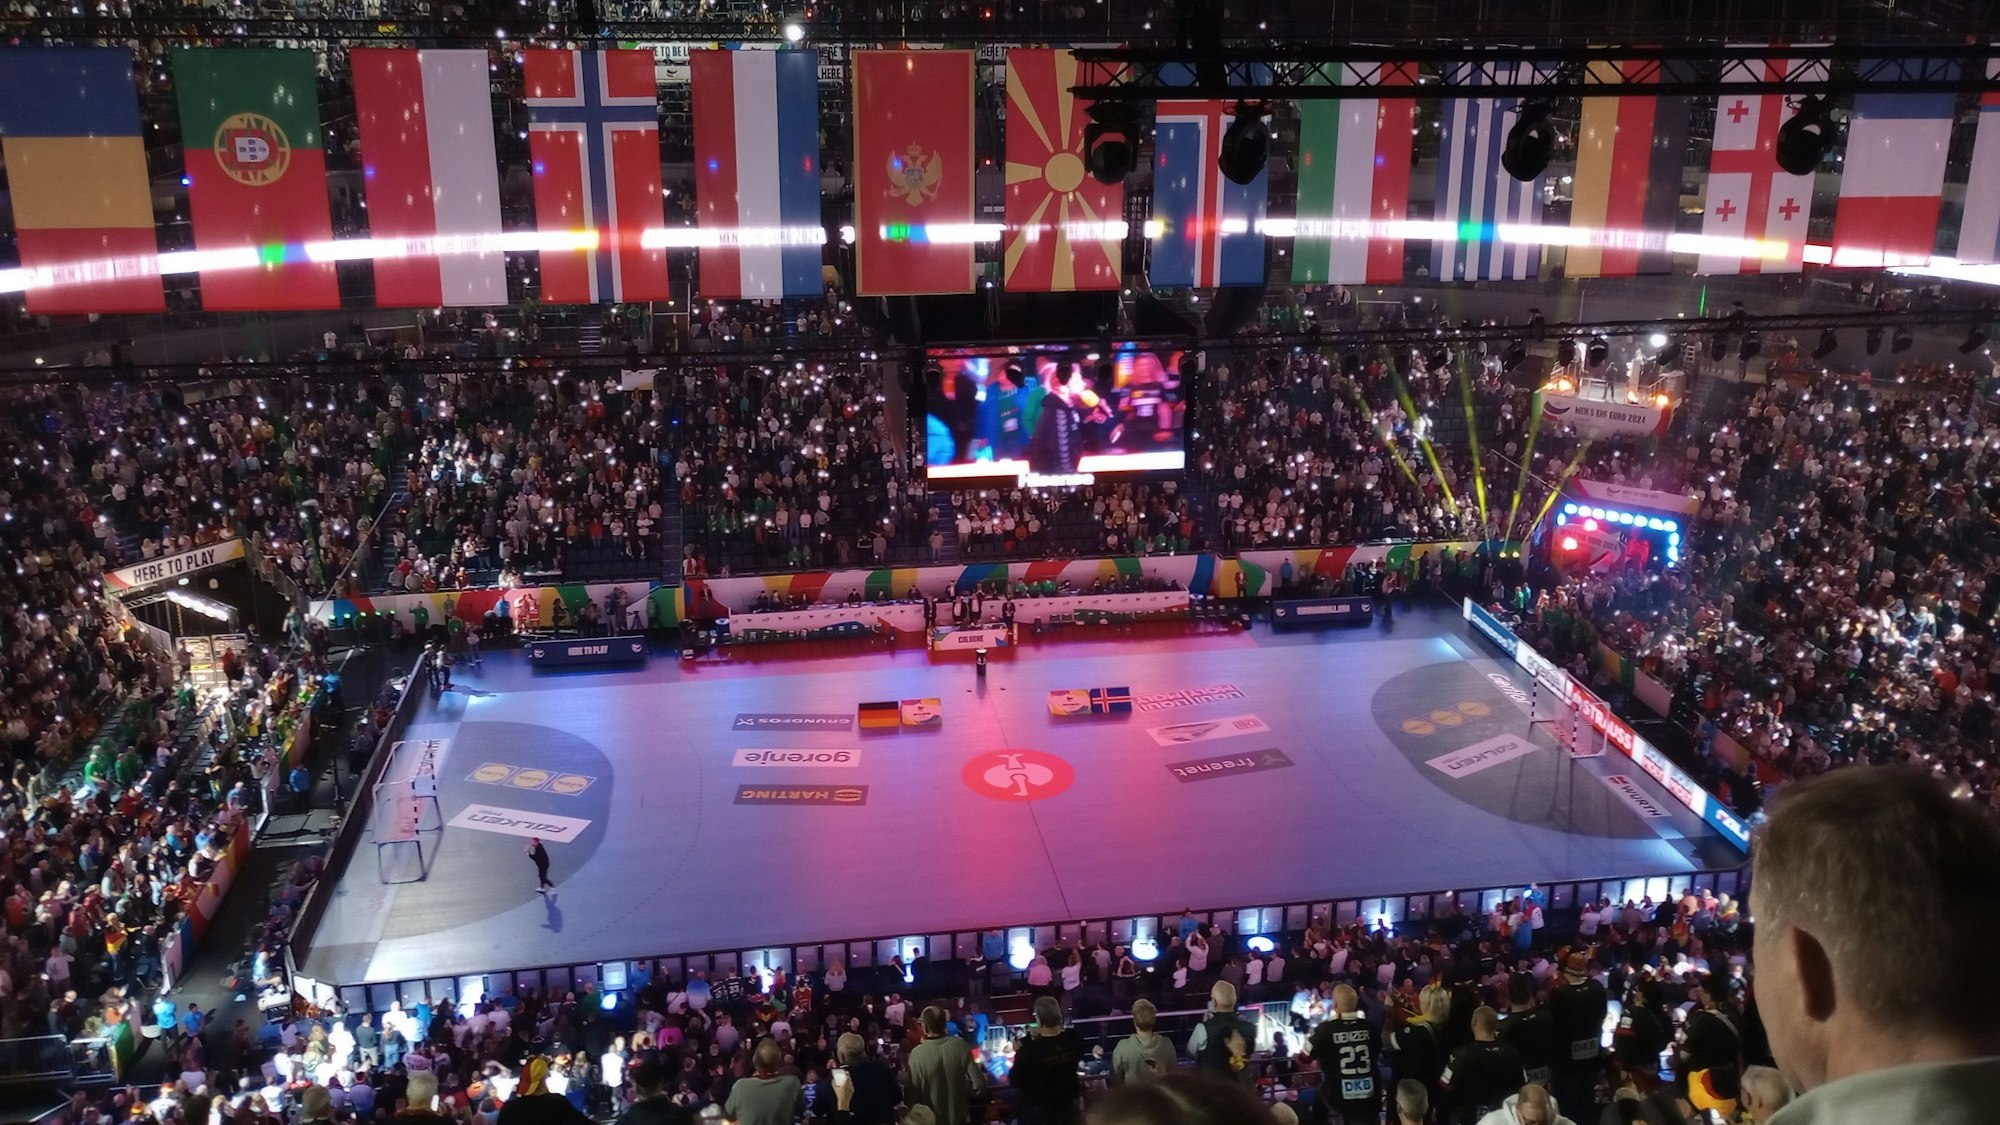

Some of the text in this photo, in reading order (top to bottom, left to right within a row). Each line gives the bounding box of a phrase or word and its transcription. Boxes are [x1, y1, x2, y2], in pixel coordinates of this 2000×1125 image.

[672, 46, 682, 57] BE
[821, 68, 841, 79] HERE
[1575, 406, 1594, 417] MENS
[1609, 411, 1627, 421] EURO
[1628, 414, 1646, 424] 2024
[134, 549, 216, 585] HERE TO PLAY
[744, 751, 851, 765] gorenje
[1447, 742, 1519, 770] FALKEN
[1174, 757, 1256, 777] freenet
[741, 791, 829, 800] HARTING
[467, 813, 568, 833] FALKEN
[1339, 1044, 1371, 1075] 23
[1344, 1079, 1372, 1092] DKB
